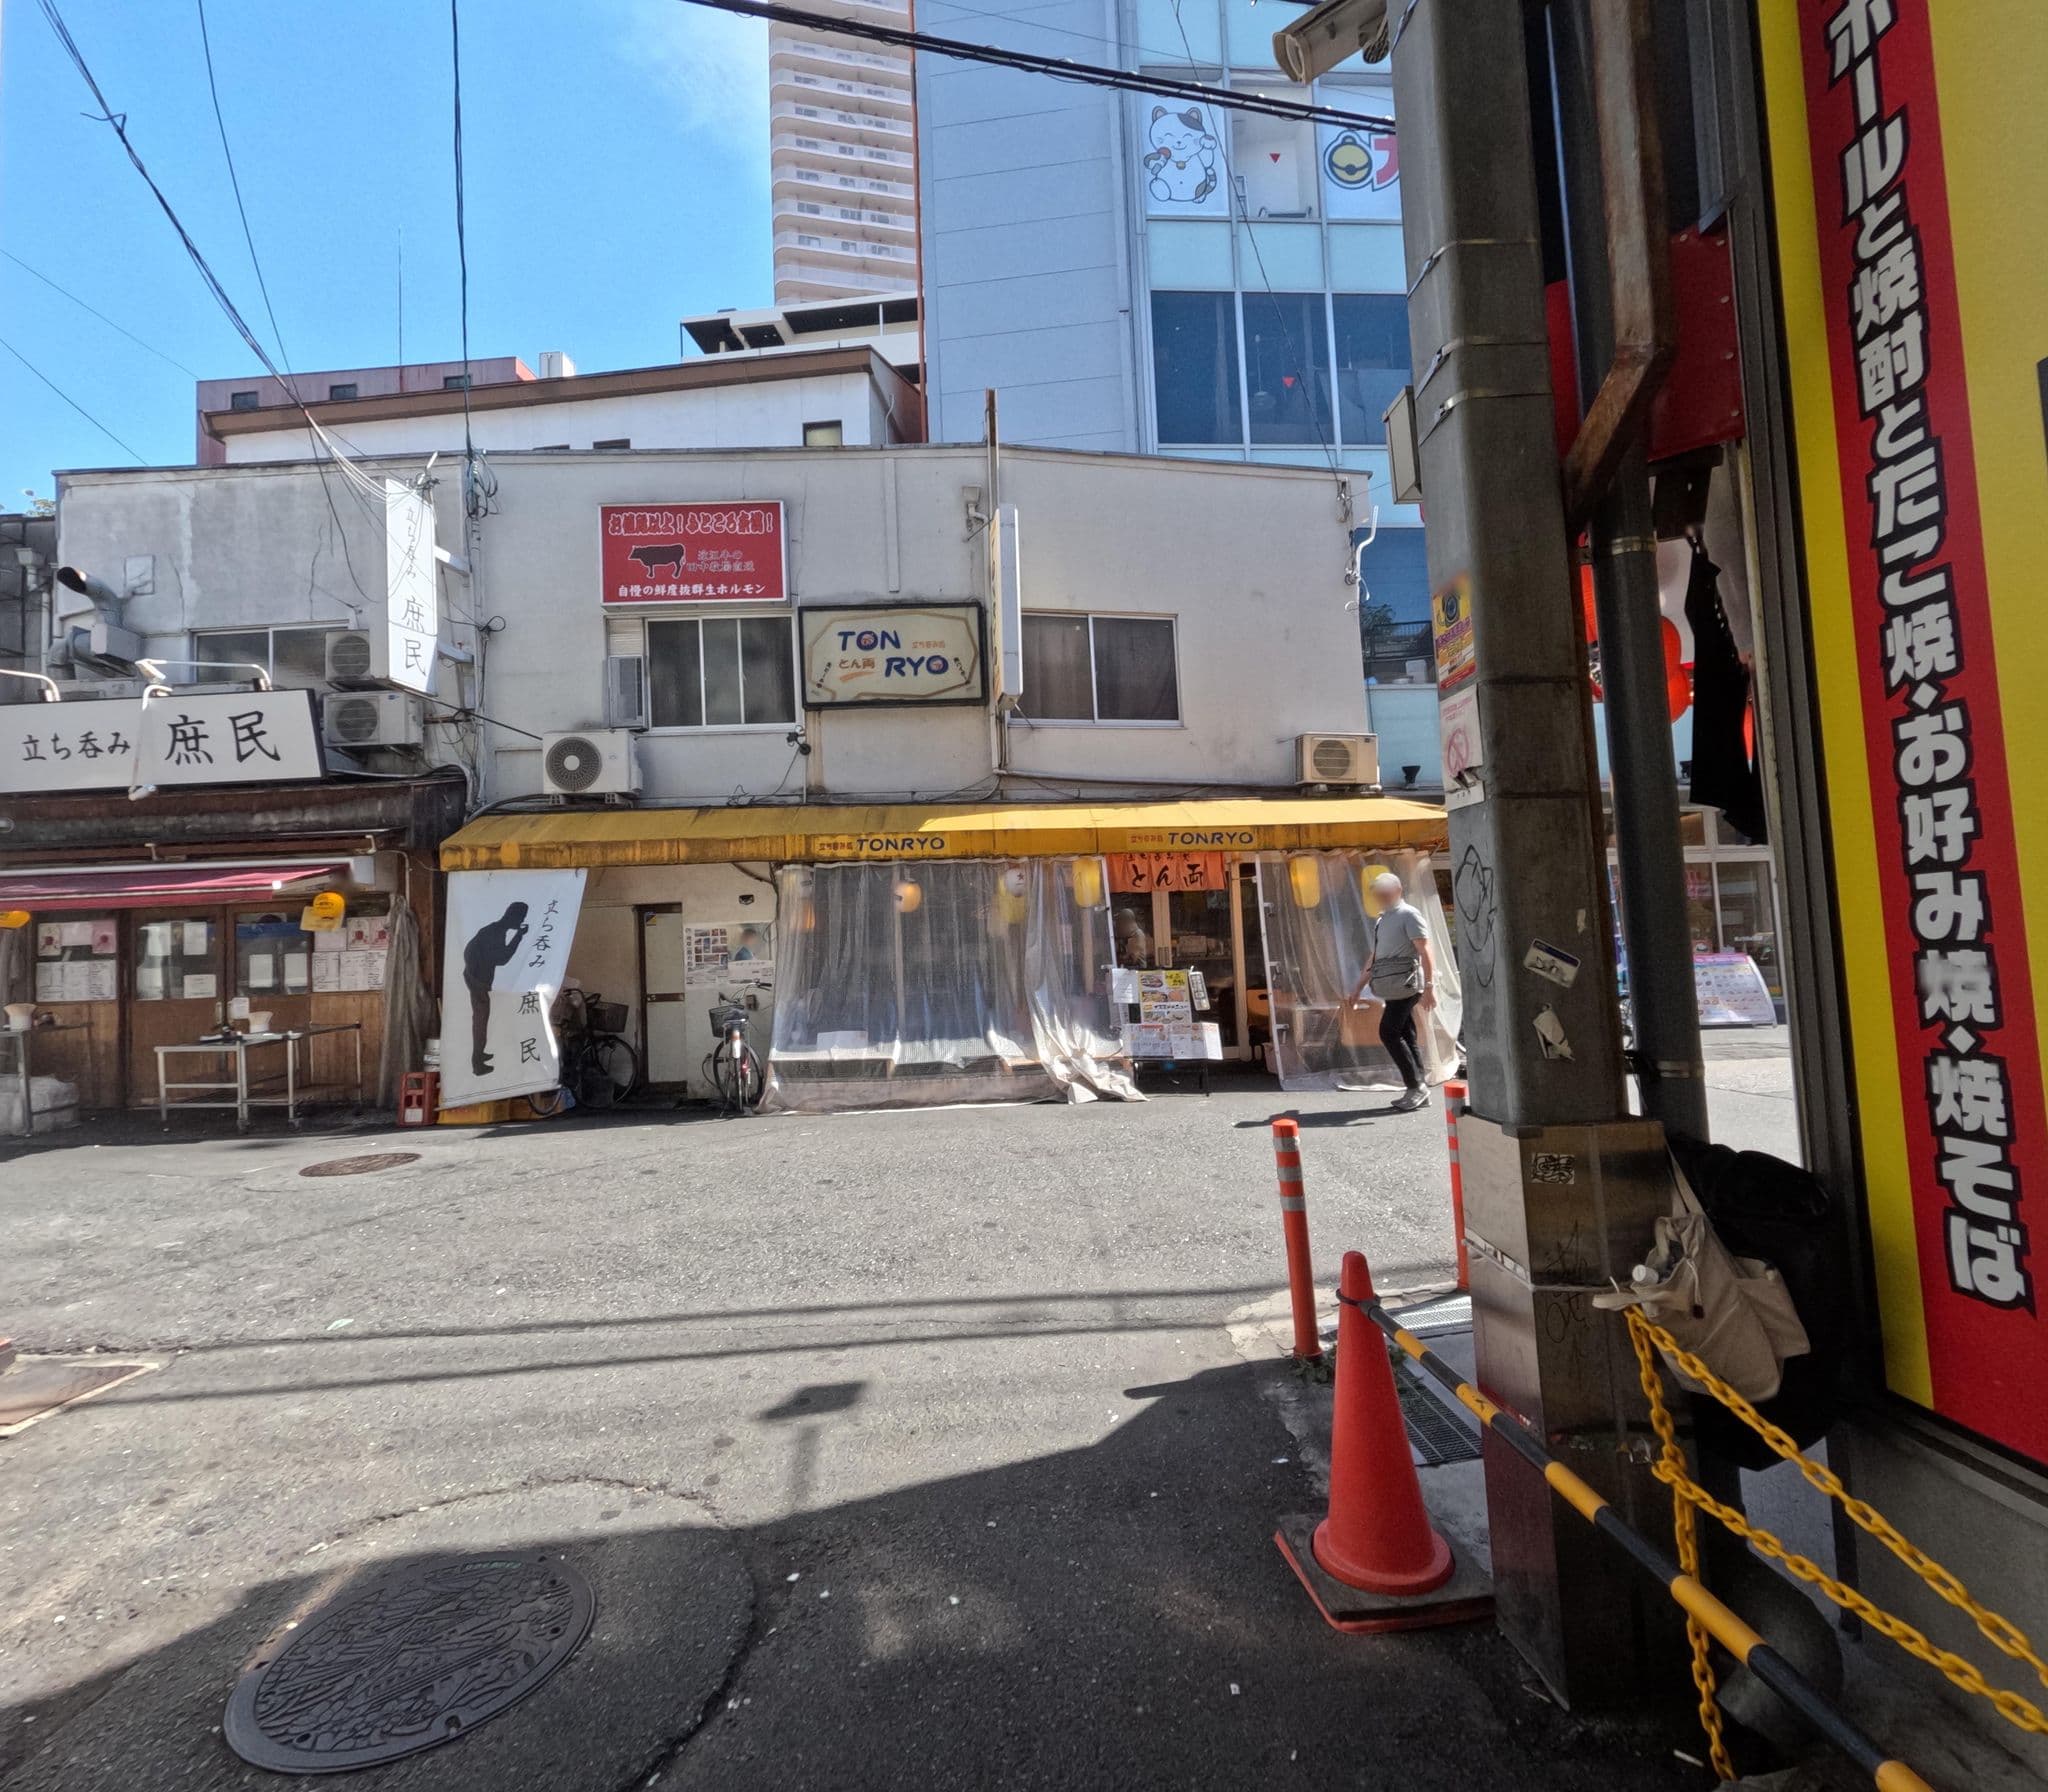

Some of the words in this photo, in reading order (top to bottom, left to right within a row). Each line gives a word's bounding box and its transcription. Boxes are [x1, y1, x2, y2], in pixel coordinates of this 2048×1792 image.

[618, 583, 766, 597] 自慢の鮮度抜群生ホルモン
[402, 595, 426, 676] 庶民
[838, 630, 901, 651] TON
[839, 658, 875, 670] とん両
[885, 655, 949, 677] RYO
[22, 732, 131, 762] 立ち呑み
[165, 710, 280, 765] 庶民
[857, 837, 944, 851] TONRYO
[1168, 832, 1253, 845] TONRYO
[1132, 864, 1203, 887] とん両
[517, 991, 541, 1063] 庶民
